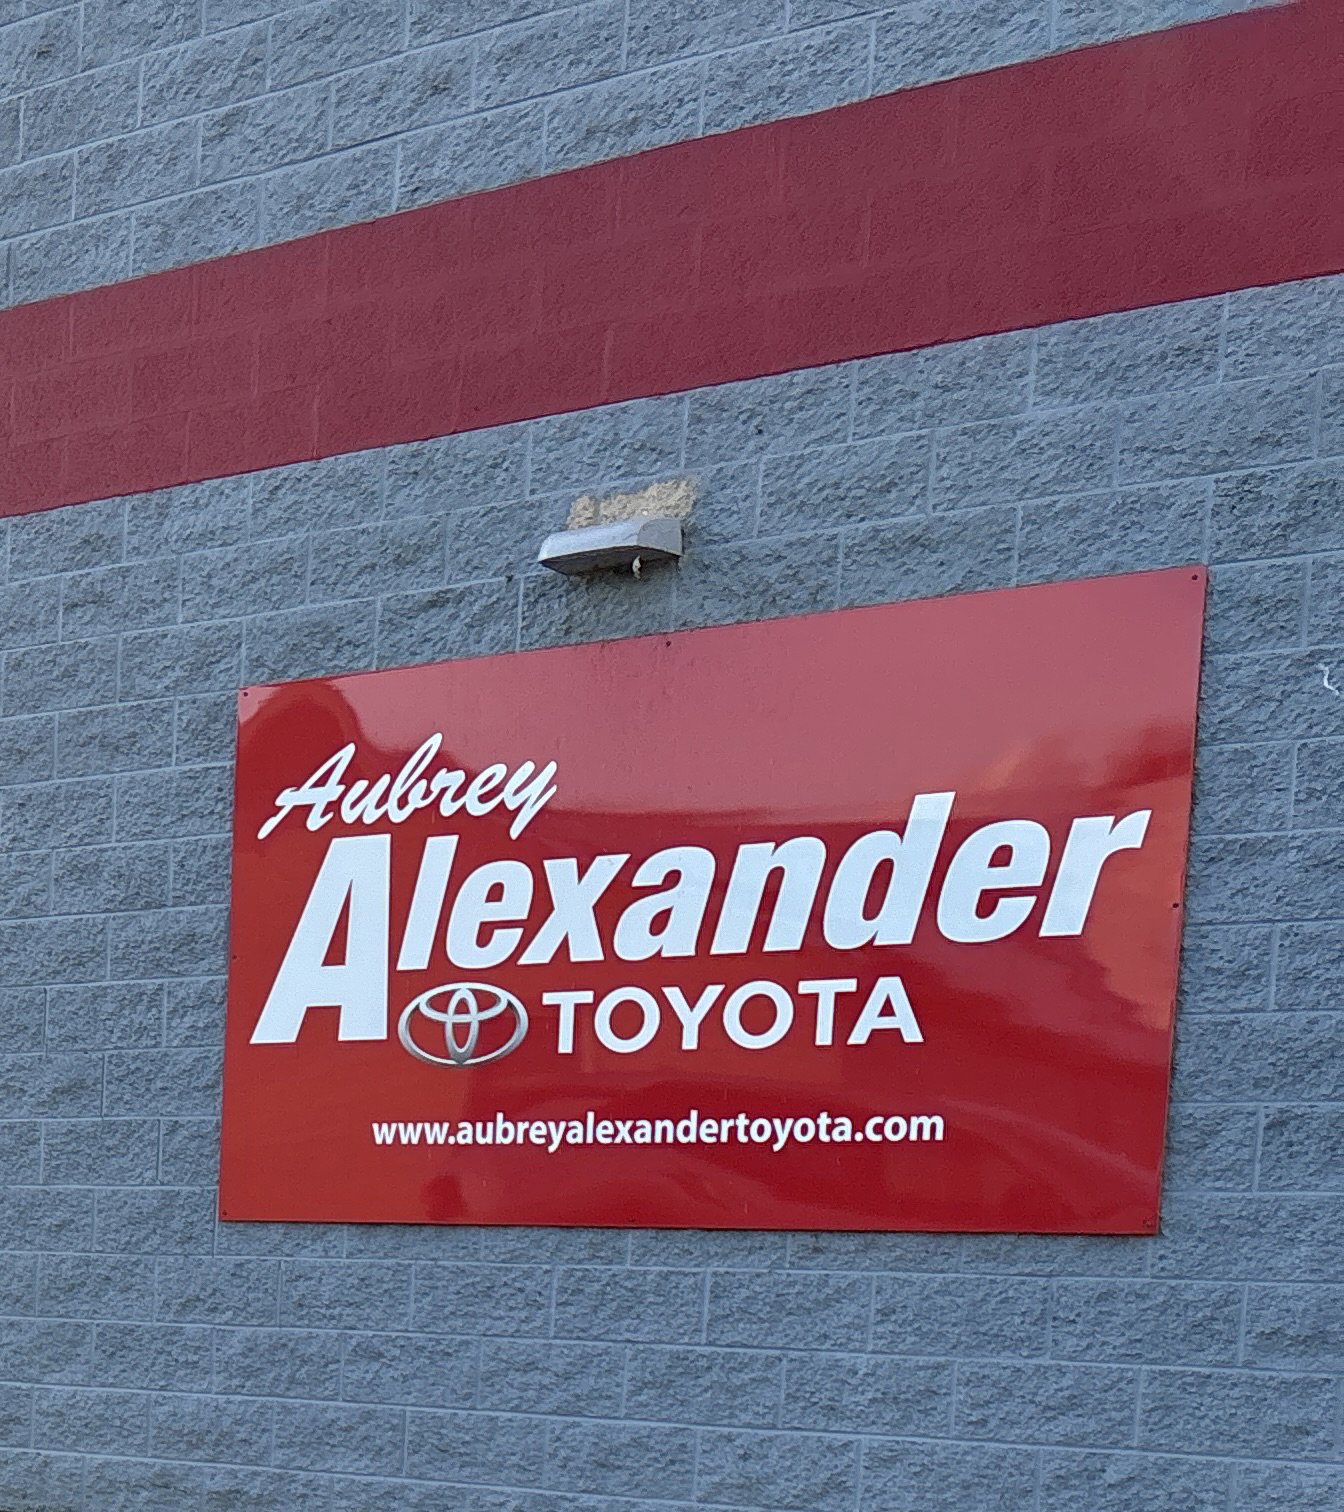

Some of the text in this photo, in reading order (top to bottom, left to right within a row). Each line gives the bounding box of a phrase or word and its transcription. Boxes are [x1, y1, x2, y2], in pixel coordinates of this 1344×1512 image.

[257, 732, 558, 841] Aubrey
[249, 790, 1152, 1045] Alexander
[541, 976, 924, 1054] TOYOTA
[371, 1108, 945, 1153] www.aubreyalexandertoyota.com
